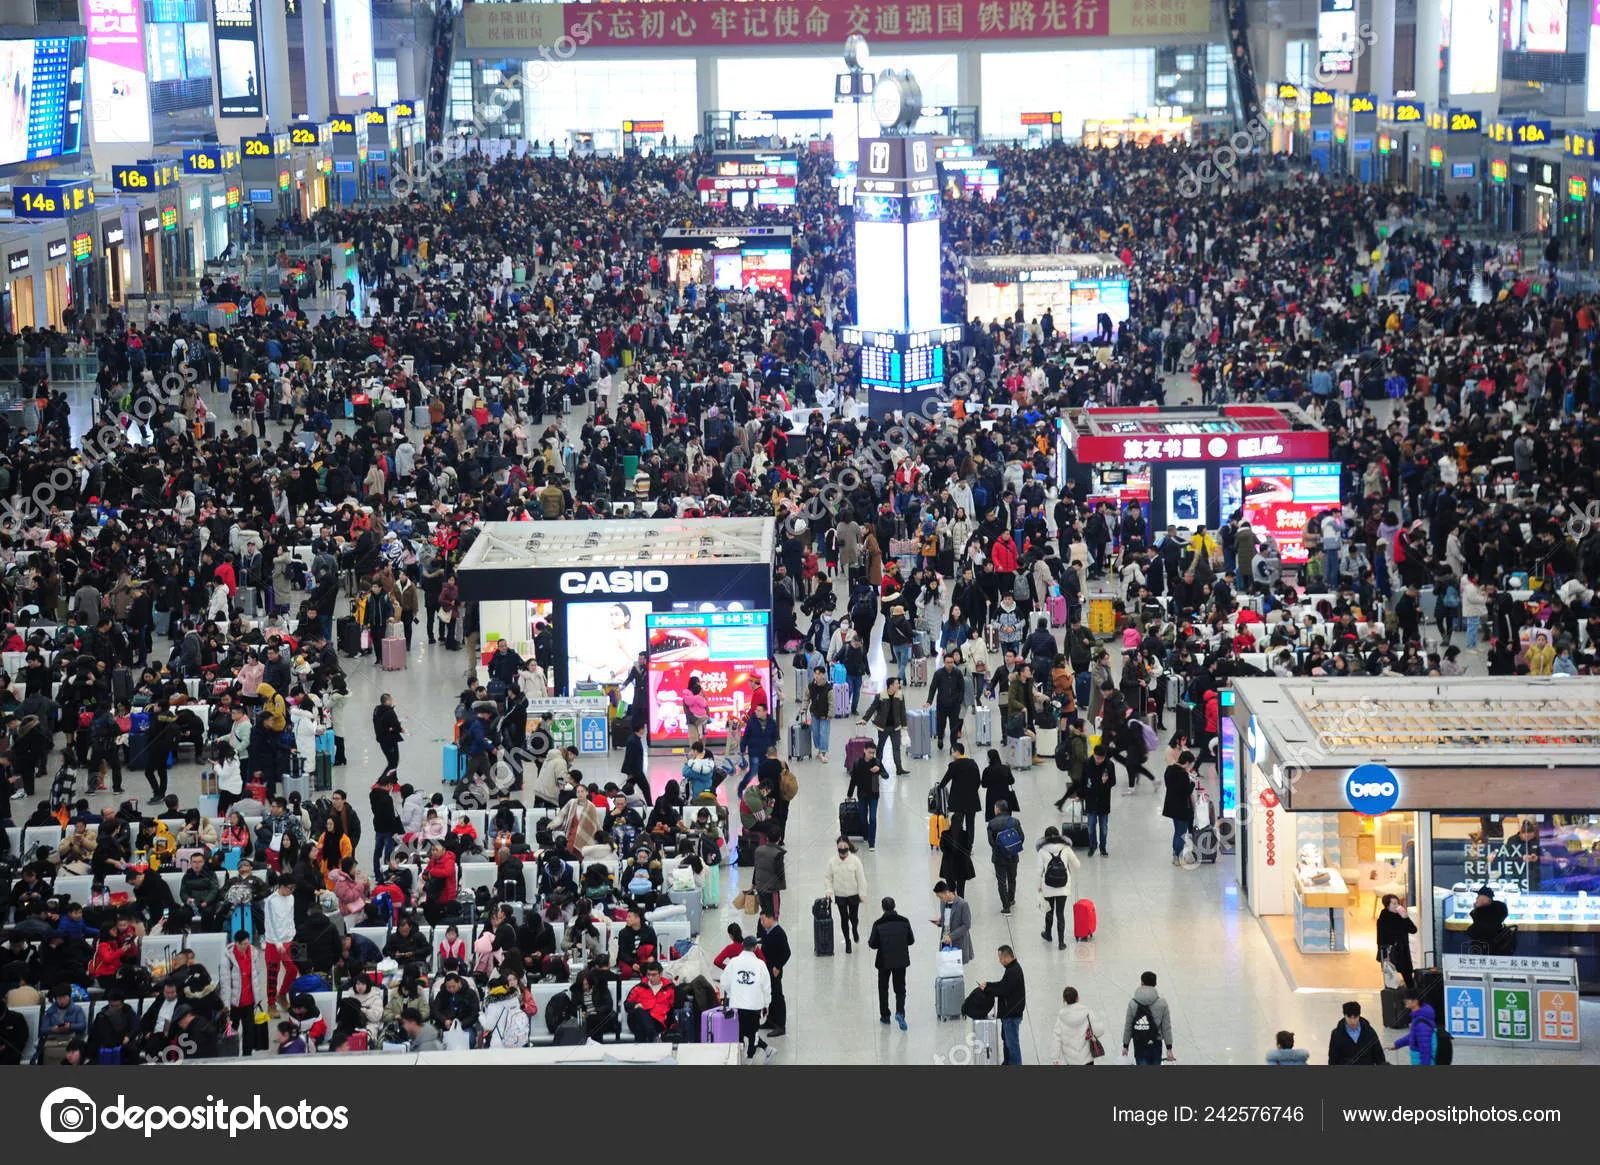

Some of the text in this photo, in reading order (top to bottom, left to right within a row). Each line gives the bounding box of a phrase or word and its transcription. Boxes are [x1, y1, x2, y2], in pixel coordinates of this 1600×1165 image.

[576, 1, 1100, 39] 不忘初心 牢记使命 交通强国 铁路先行
[1397, 104, 1420, 120] 22A
[331, 119, 352, 132] 24B
[1451, 113, 1477, 130] 20A
[292, 129, 315, 143] 22B
[1518, 124, 1545, 142] 18A
[245, 140, 269, 155] 20B
[189, 154, 215, 170] 18B
[119, 170, 148, 188] 16B
[21, 192, 56, 212] 14B
[560, 570, 668, 594] CASIO
[1350, 780, 1395, 798] breo
[1464, 843, 1522, 857] RELAX
